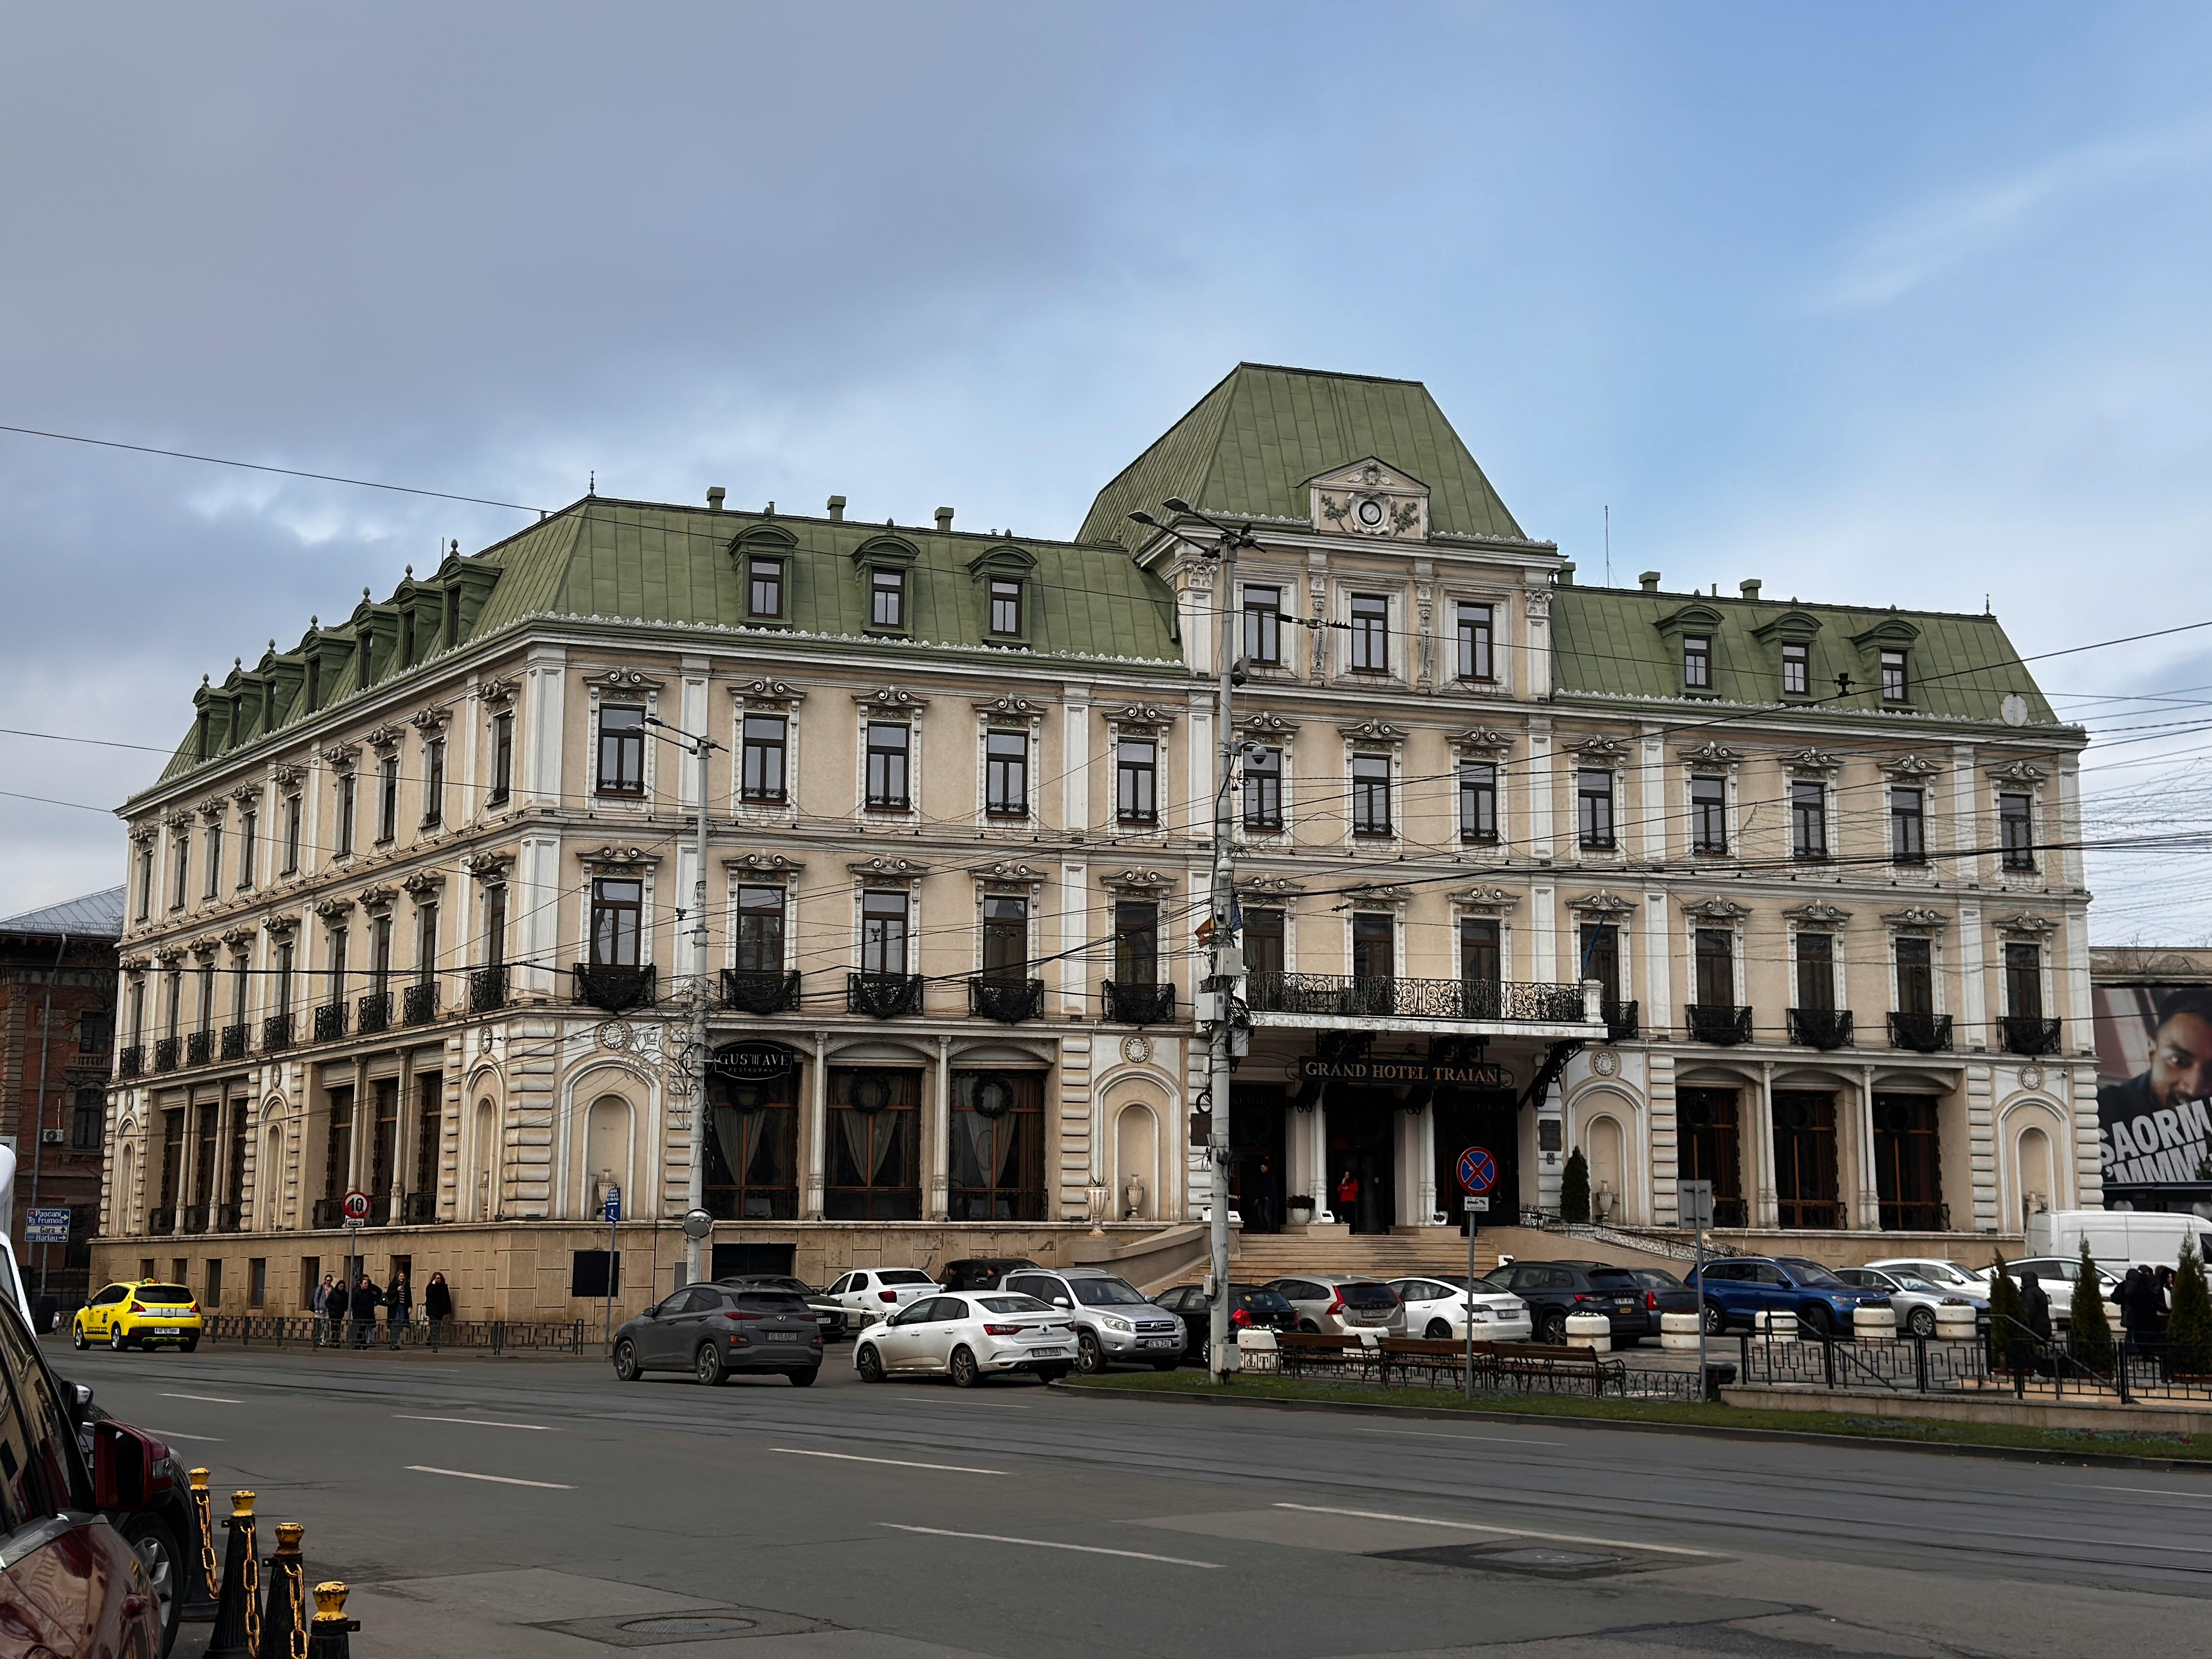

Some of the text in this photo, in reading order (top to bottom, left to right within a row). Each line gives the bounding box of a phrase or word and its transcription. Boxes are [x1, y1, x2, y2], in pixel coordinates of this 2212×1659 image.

[718, 1053, 789, 1065] GUSTAVE
[1306, 1062, 1497, 1082] GRAND HOTEL TRAIAN
[2098, 1097, 2212, 1166] SAORM
[349, 1198, 364, 1213] 10
